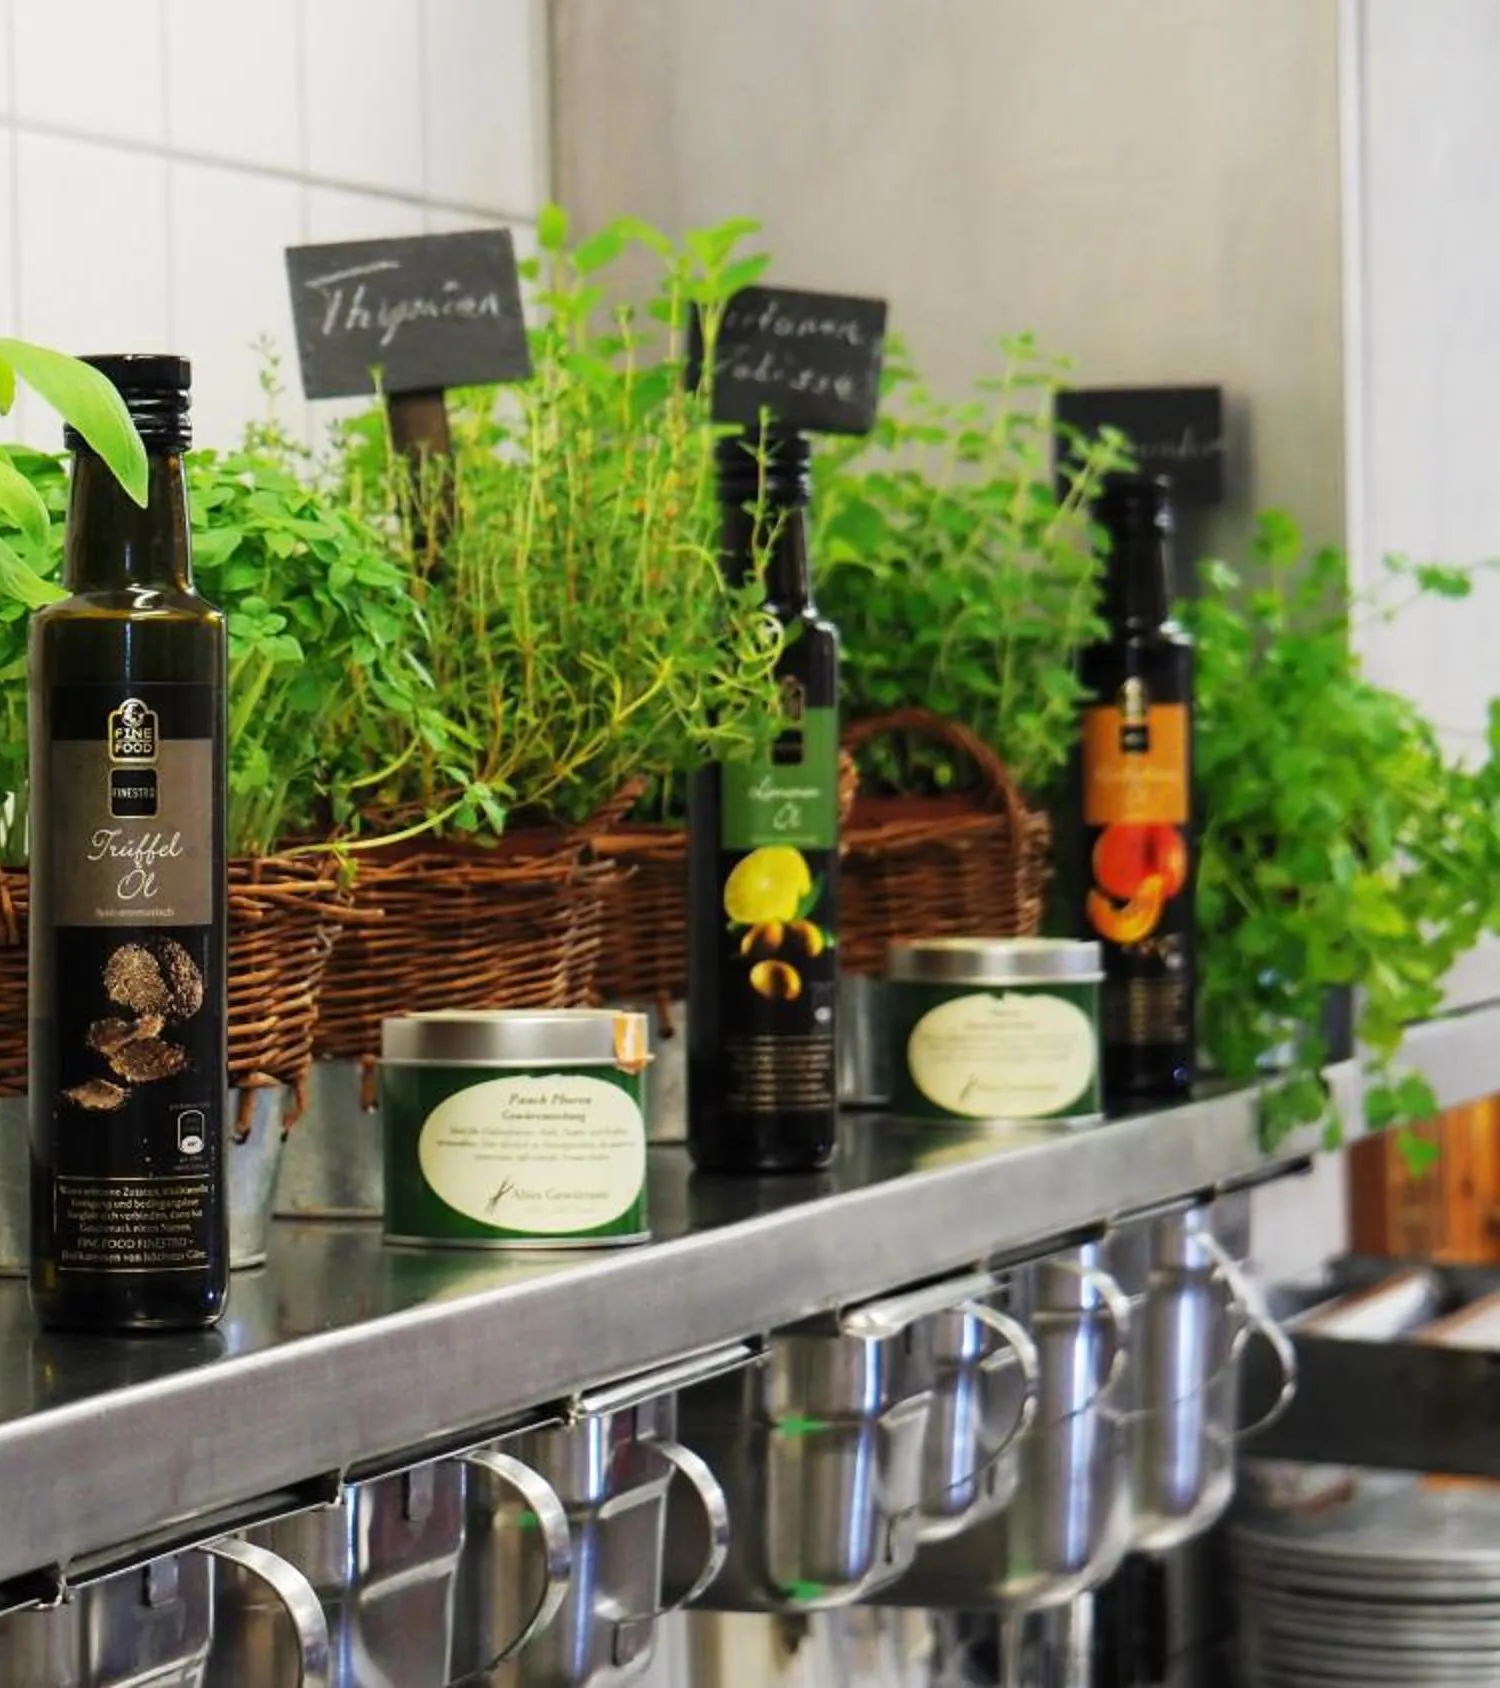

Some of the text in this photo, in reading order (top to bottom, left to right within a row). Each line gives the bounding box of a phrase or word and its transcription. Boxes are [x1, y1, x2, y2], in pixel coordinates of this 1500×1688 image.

[114, 727, 153, 738] FINE
[114, 741, 153, 754] FOOD
[87, 829, 184, 865] Trüffel
[116, 862, 162, 900] Öl
[102, 1237, 136, 1248] FOOD
